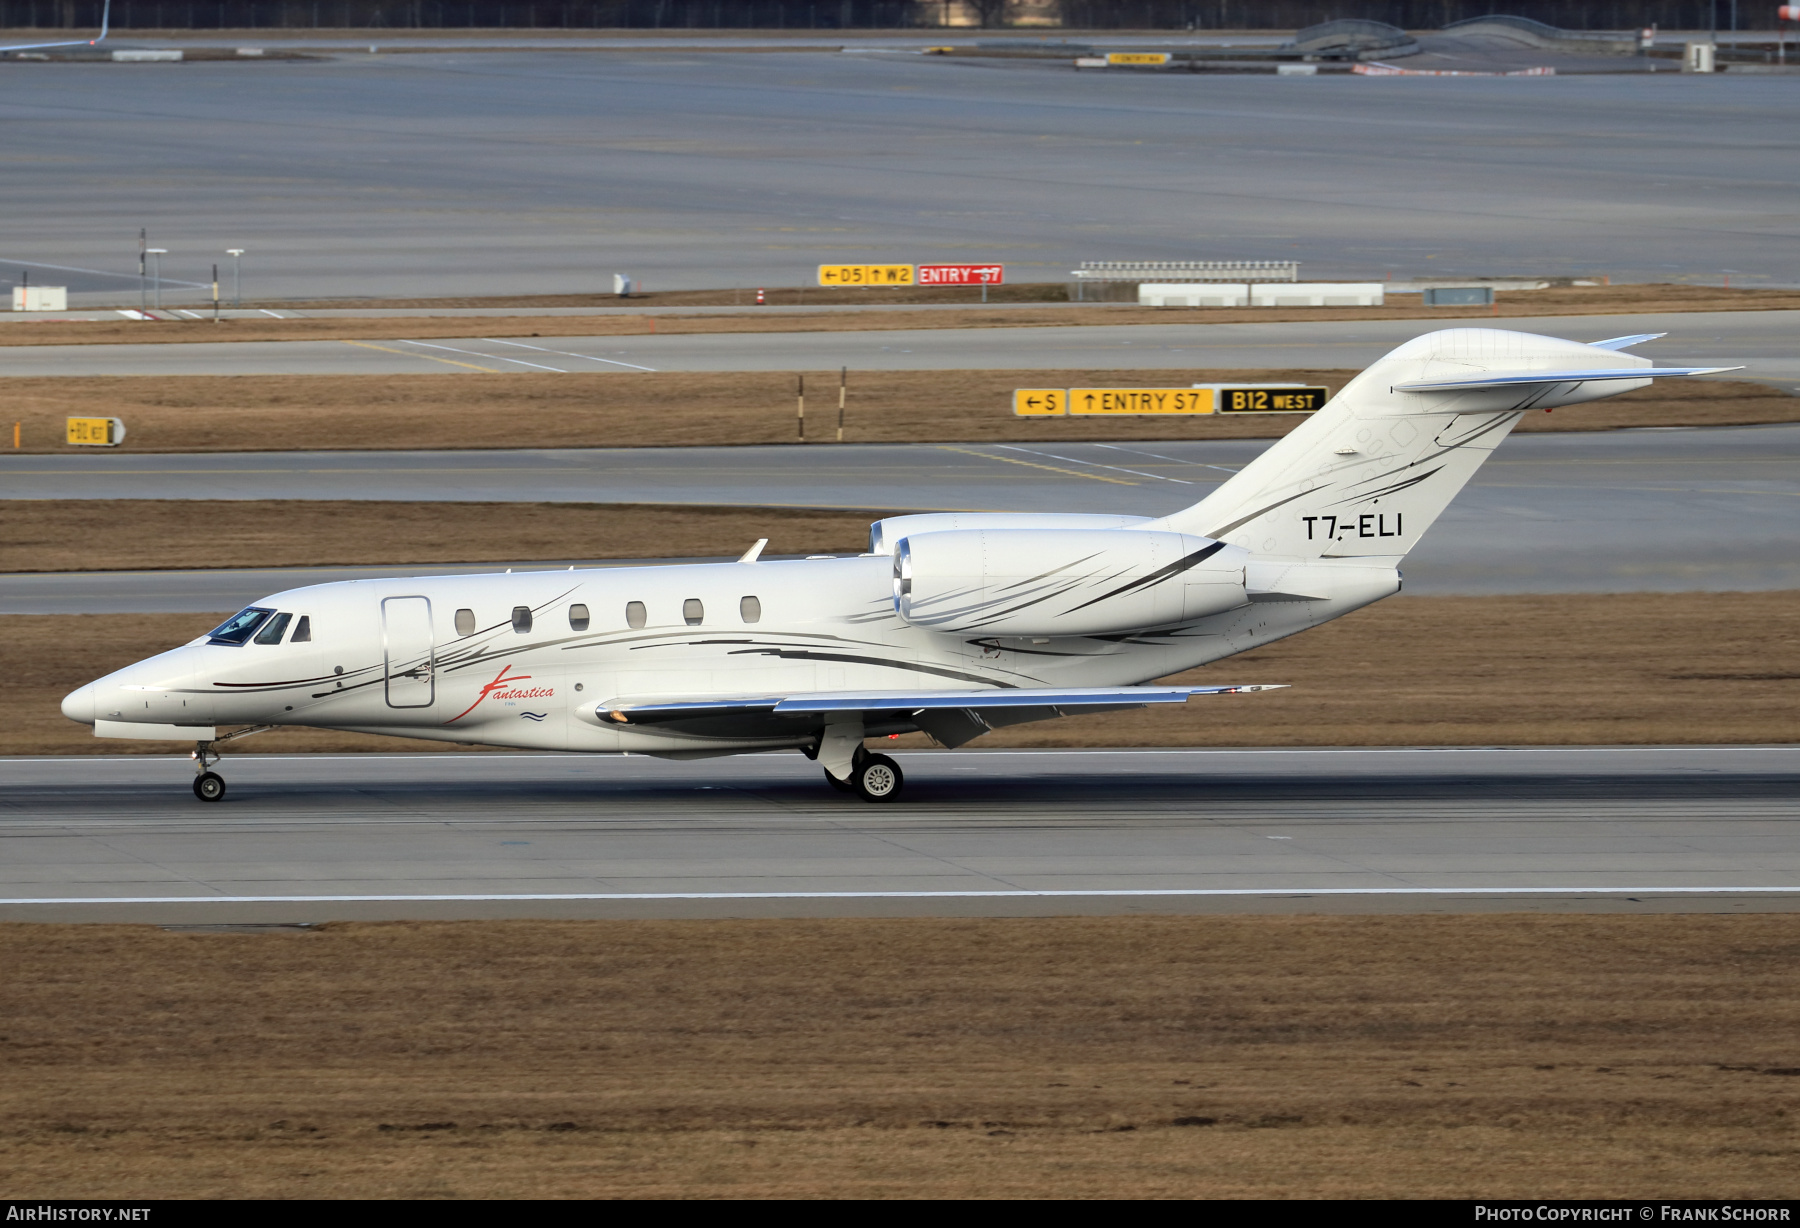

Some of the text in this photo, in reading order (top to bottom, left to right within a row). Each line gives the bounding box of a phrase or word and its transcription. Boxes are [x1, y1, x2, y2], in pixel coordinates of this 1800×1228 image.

[841, 268, 909, 282] D5 W2
[920, 268, 971, 282] ENTRY
[1045, 394, 1056, 411] S
[1102, 393, 1200, 410] ENTRY S7
[1232, 391, 1315, 410] B12 WEST
[1302, 512, 1402, 540] T7-ELI
[442, 664, 555, 725] Fantastica
